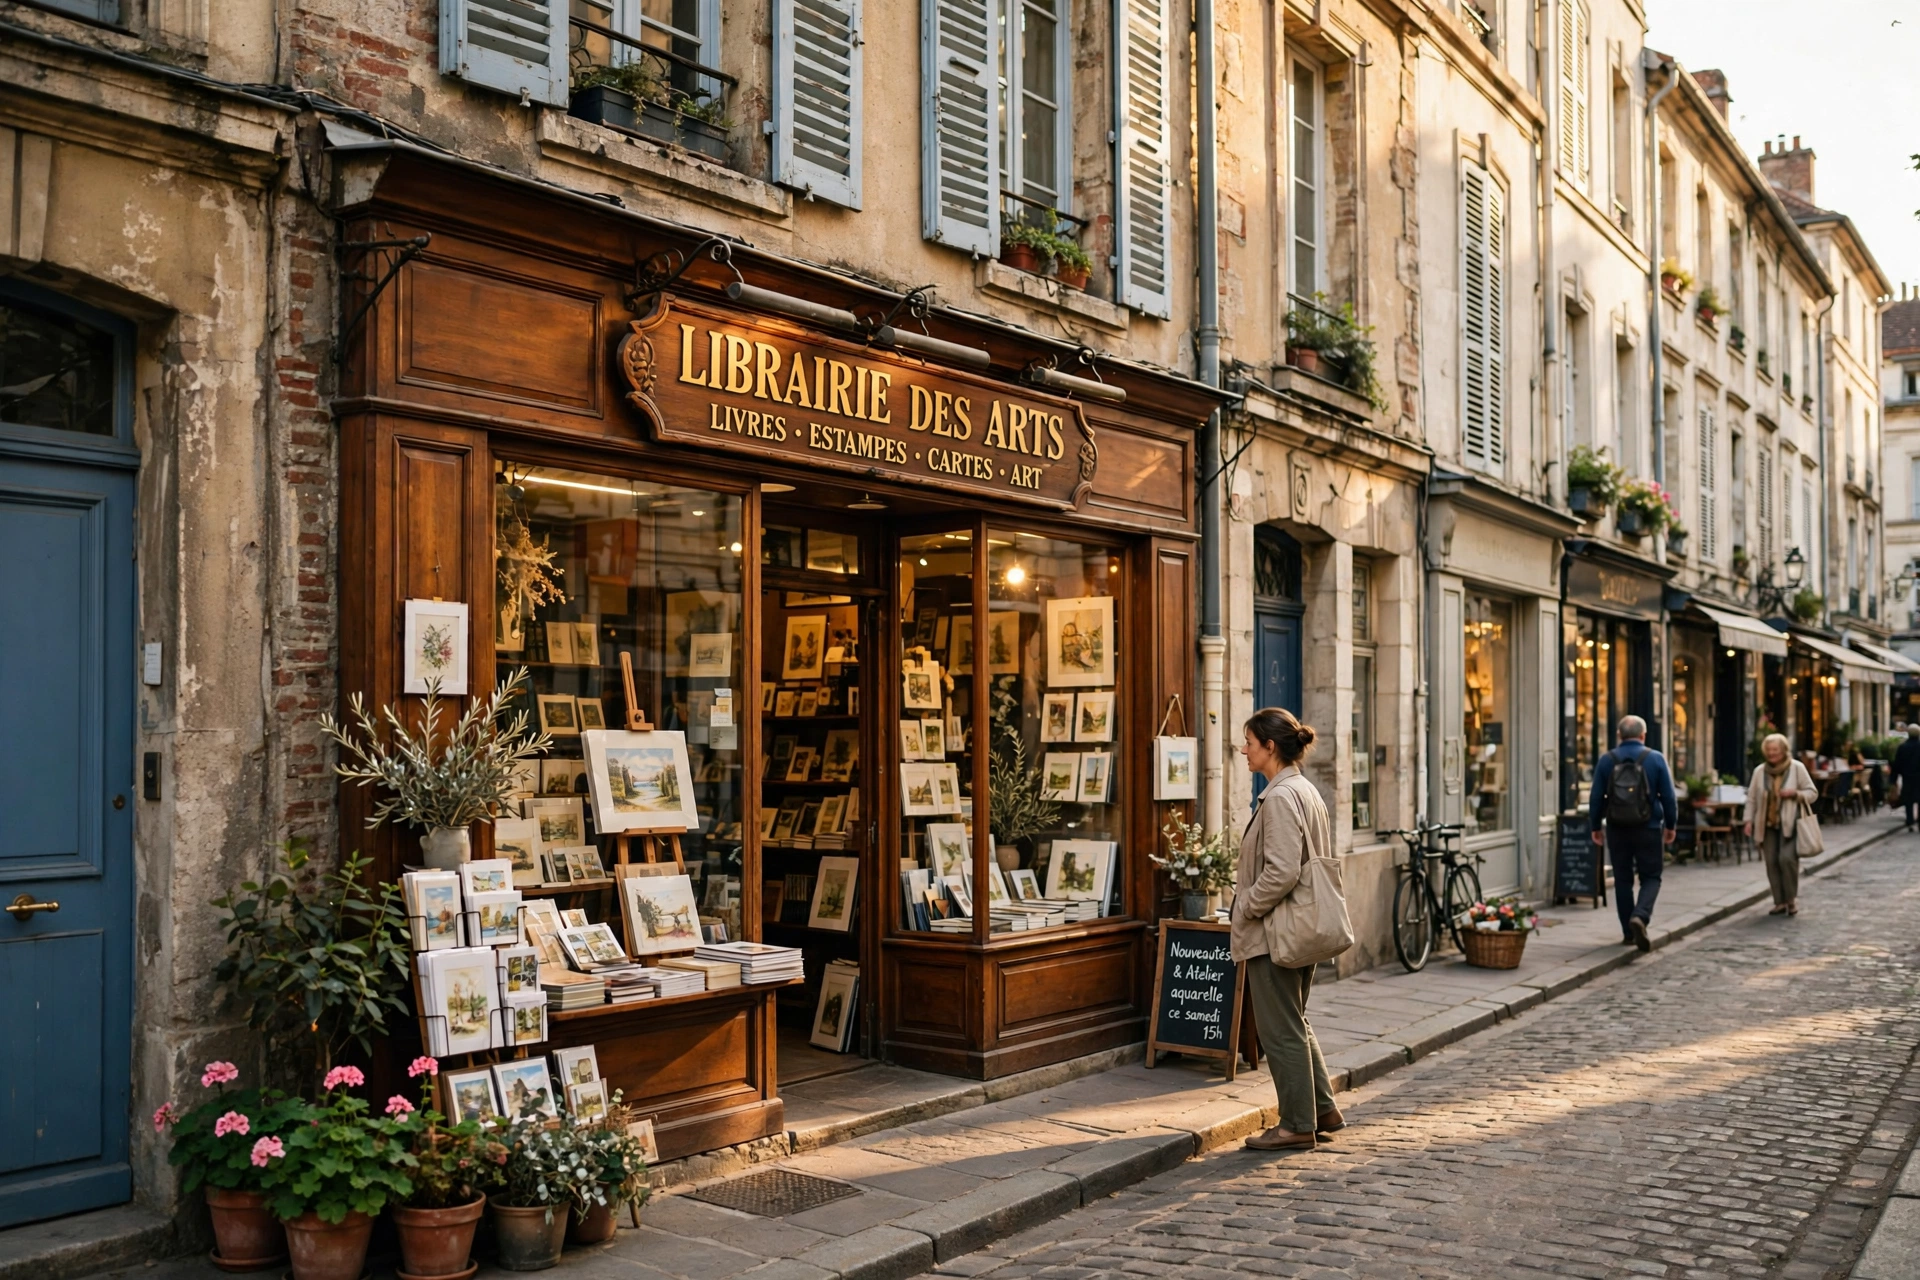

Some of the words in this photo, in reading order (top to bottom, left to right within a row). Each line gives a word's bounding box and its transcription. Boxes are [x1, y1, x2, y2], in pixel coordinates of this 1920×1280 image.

[679, 323, 892, 424] LIBRAIRIE
[909, 384, 972, 441] DES
[985, 400, 1065, 460] ARTS
[710, 404, 787, 442] LIVRES
[809, 423, 907, 465] ESTAMPES
[928, 449, 993, 481] CARTES
[1010, 464, 1043, 490] ART
[1170, 942, 1231, 961] Nouveautés
[1173, 964, 1182, 979] &
[1185, 964, 1224, 982] Atelier
[1170, 985, 1223, 1005] aquarelle
[1168, 1009, 1180, 1019] ce
[1184, 1008, 1220, 1023] samedi
[1203, 1025, 1222, 1040] 15h
